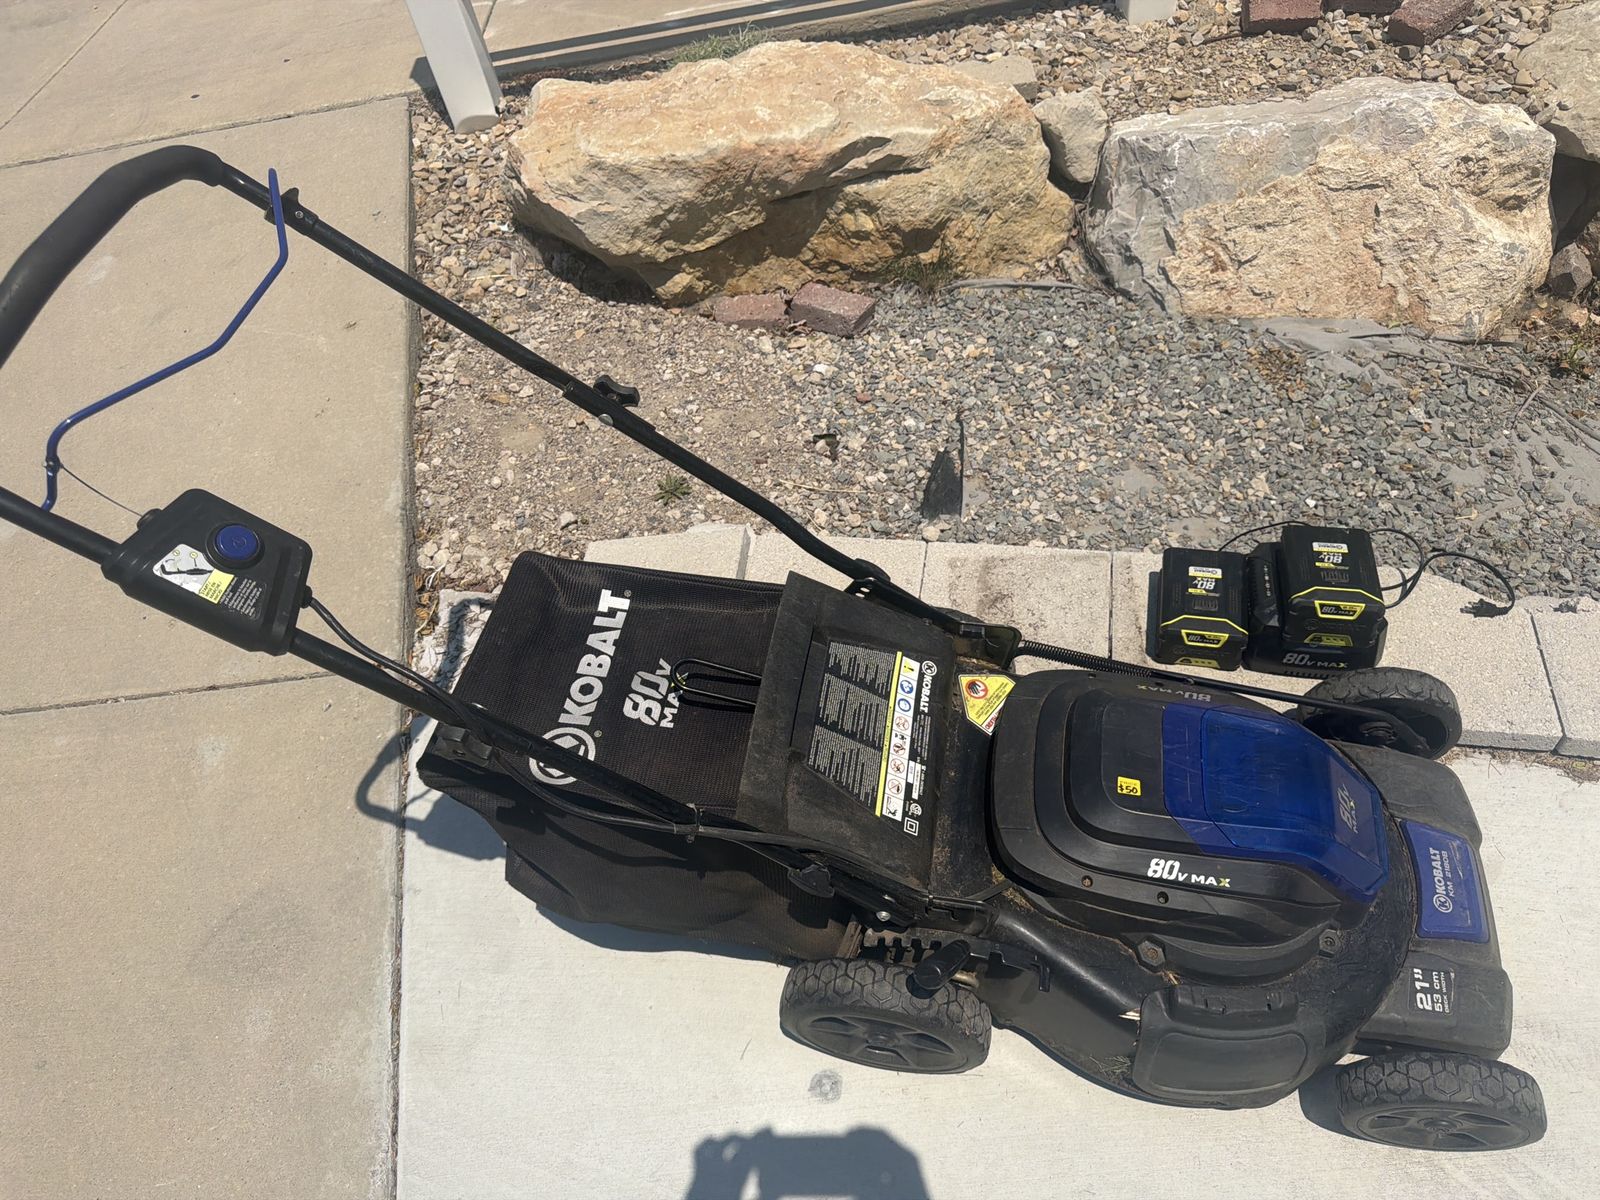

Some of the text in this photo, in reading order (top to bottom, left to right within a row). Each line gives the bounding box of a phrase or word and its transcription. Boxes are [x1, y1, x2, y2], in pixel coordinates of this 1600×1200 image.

[558, 588, 630, 726] KOBALT
[1317, 661, 1349, 669] MAX
[920, 675, 933, 714] KOBALT
[1118, 783, 1138, 794] $50
[1191, 874, 1231, 888] MAX
[1429, 847, 1446, 895] KOBALT
[1446, 881, 1455, 897] KM
[1432, 971, 1443, 1012] 53 cm
